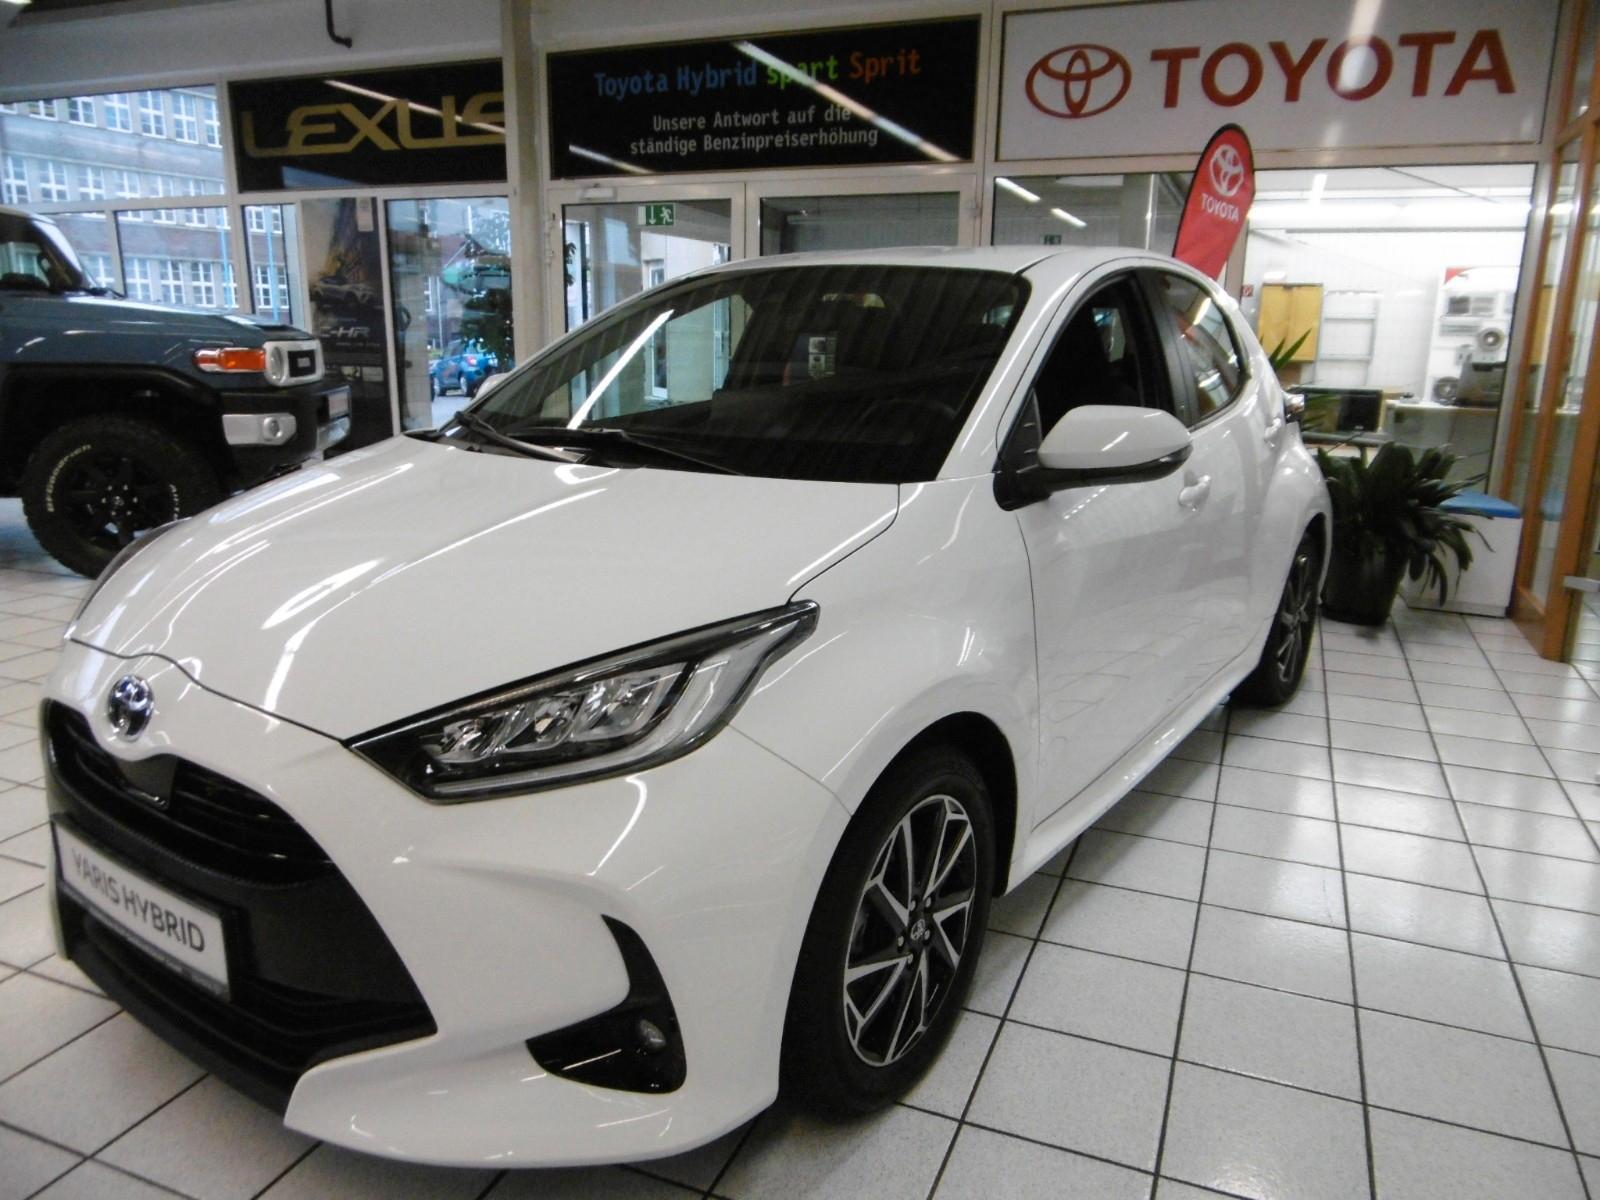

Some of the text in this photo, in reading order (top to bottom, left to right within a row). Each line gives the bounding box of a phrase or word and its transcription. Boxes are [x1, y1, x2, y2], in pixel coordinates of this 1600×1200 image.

[594, 70, 669, 101] Toyota
[676, 61, 758, 96] Hybrid
[850, 49, 921, 84] Sprit
[1150, 28, 1516, 109] TOYOTA
[652, 102, 851, 132] Unsere Antwort auf die
[630, 127, 879, 156] ständige Benzinpreiserhöhung
[1202, 193, 1239, 222] TOYOTA
[72, 848, 205, 952] YARIS HYBRID
